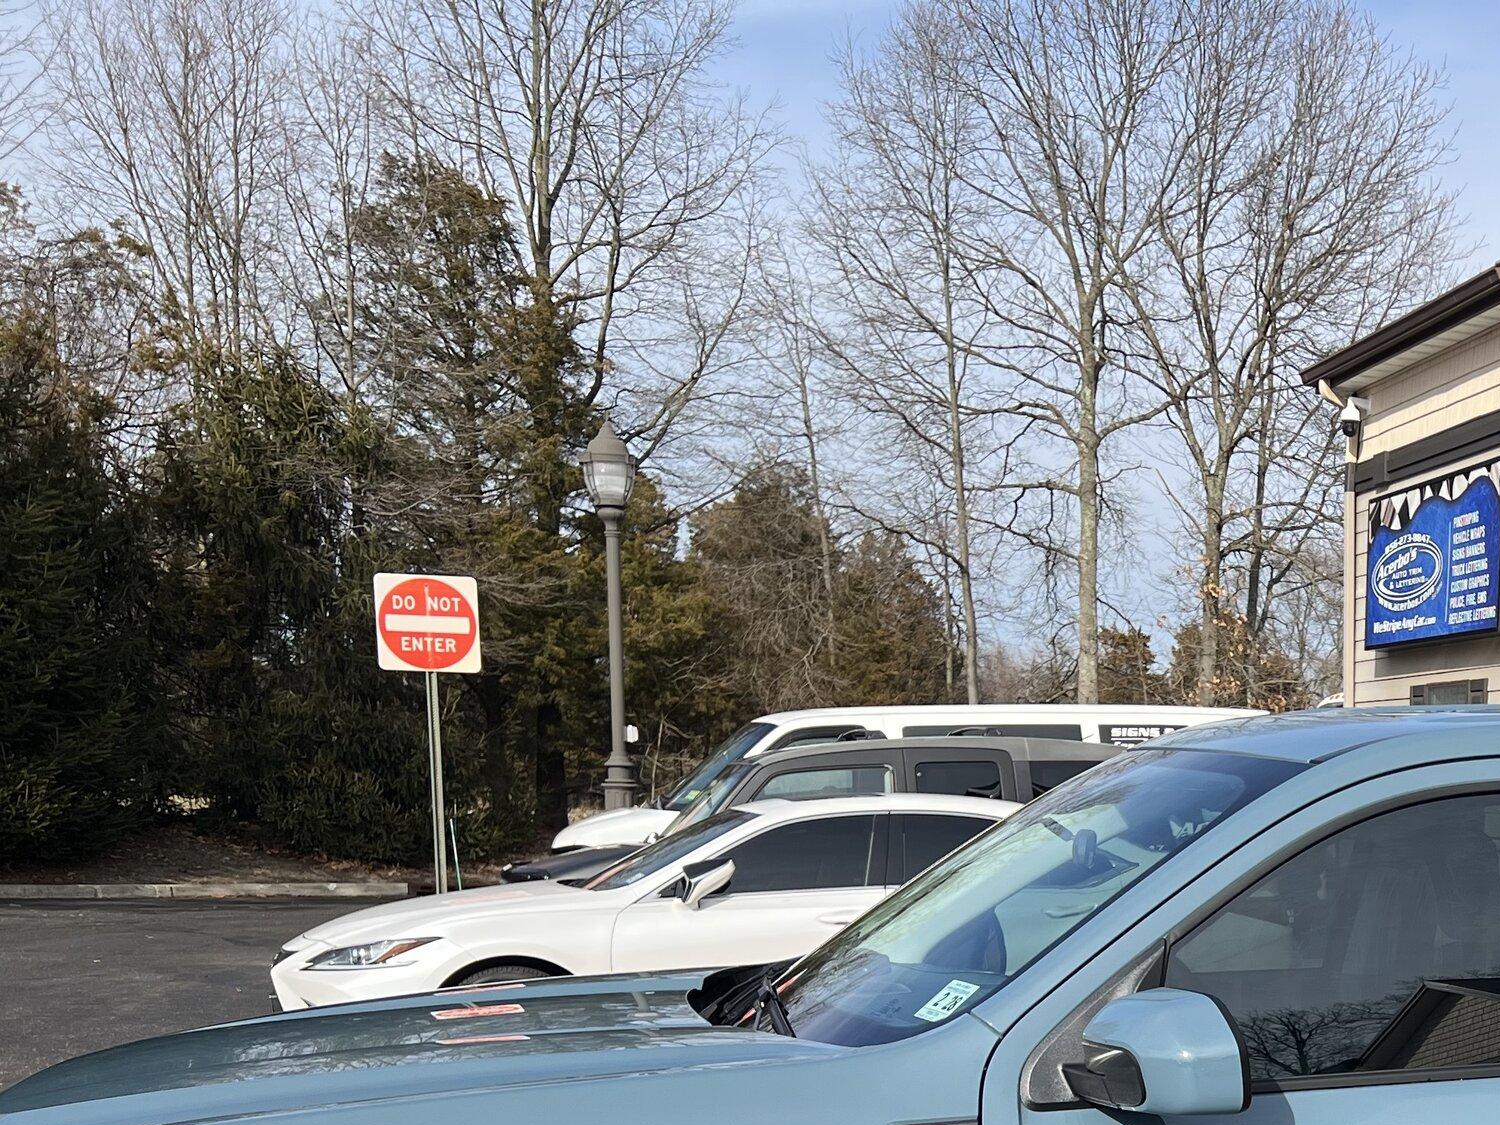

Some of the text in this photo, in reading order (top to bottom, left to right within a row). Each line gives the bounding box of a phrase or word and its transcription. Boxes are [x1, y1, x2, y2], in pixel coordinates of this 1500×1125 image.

[392, 595, 461, 612] DO NOT
[401, 636, 456, 653] ENTER
[1110, 727, 1161, 738] SIGNS
